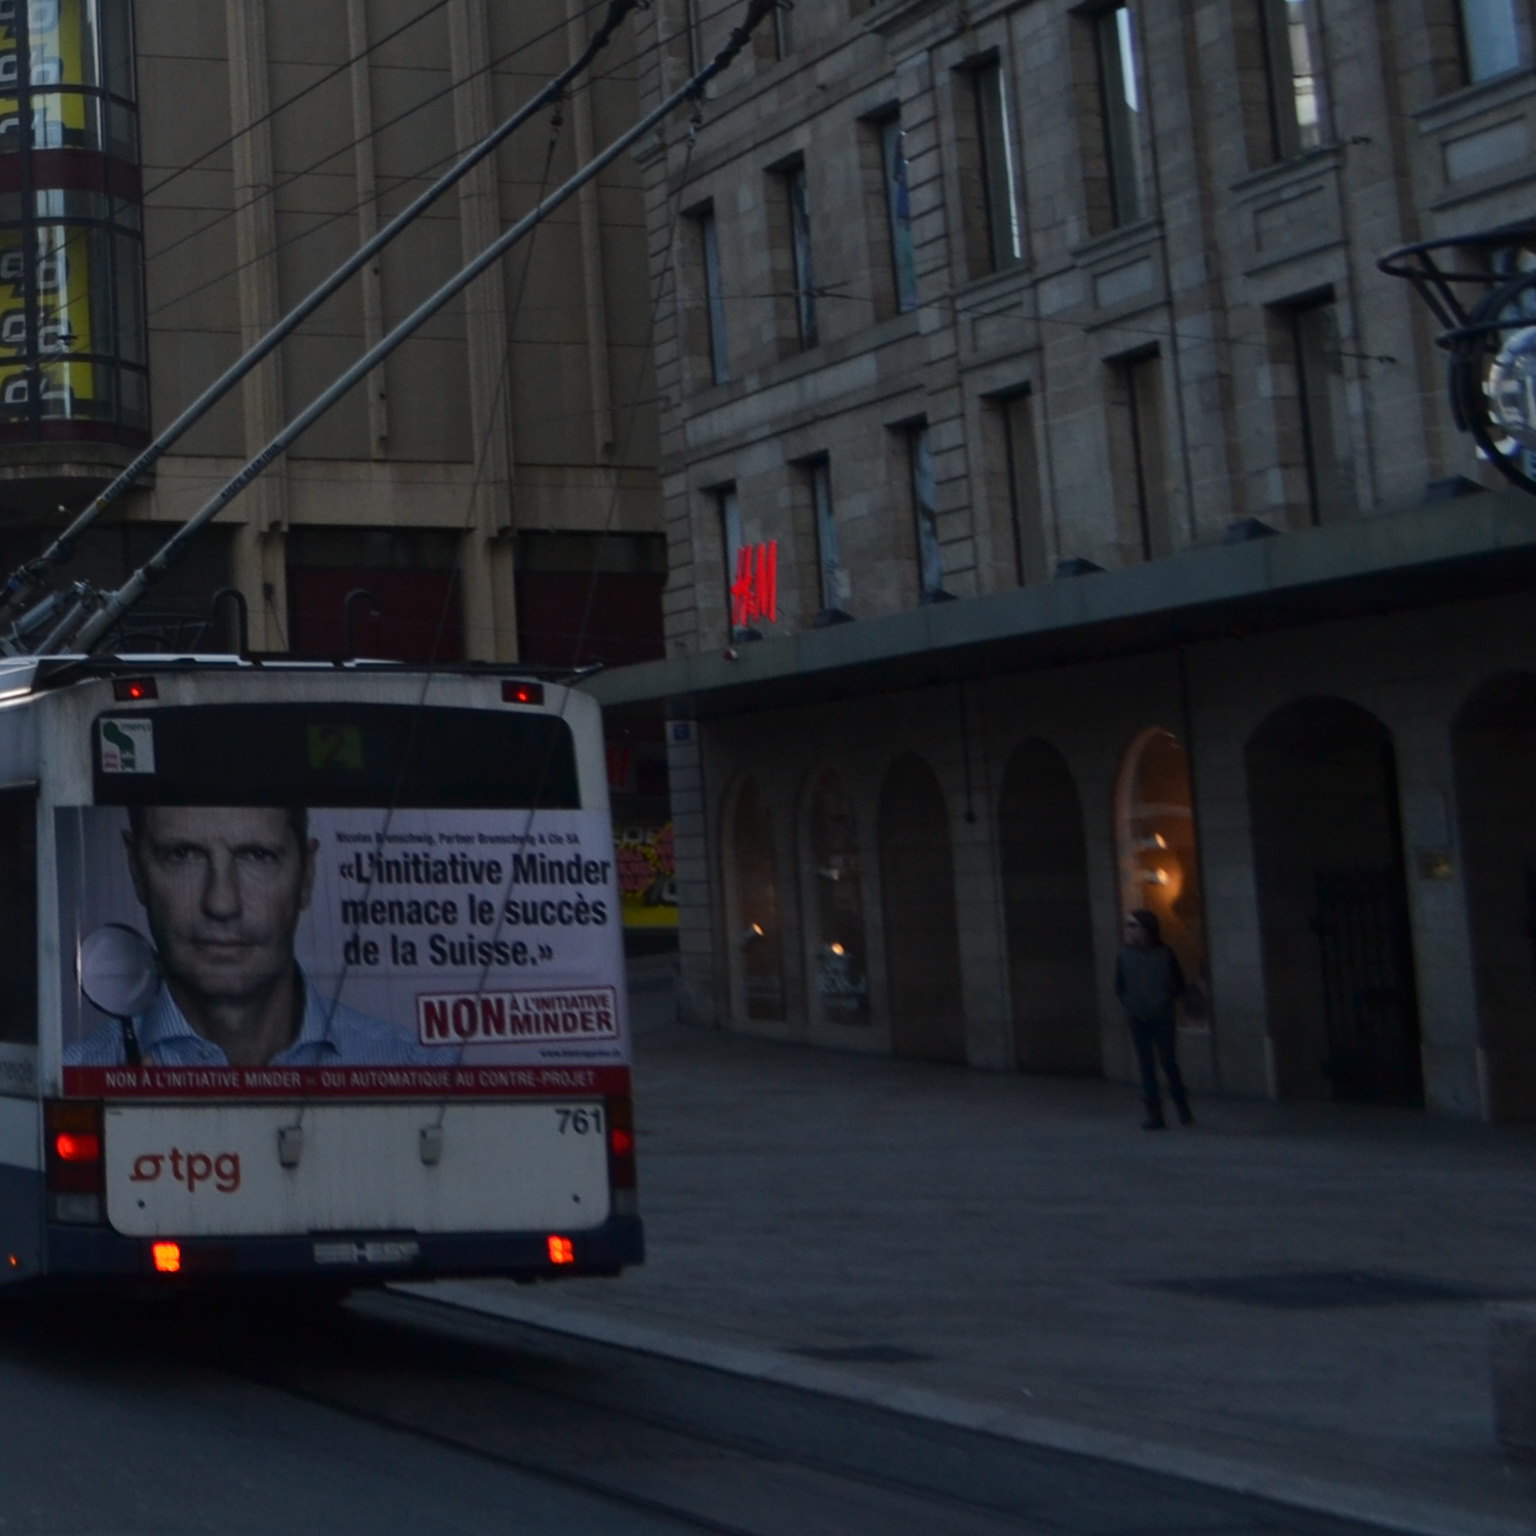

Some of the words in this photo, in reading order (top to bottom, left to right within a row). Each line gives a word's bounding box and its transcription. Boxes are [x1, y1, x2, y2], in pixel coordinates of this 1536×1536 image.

[512, 851, 611, 885] Minder
[341, 898, 458, 926] menace
[469, 894, 494, 925] le
[505, 891, 608, 926] succès
[344, 934, 379, 966] de
[391, 934, 418, 966] la
[423, 997, 507, 1039] NON
[524, 994, 610, 1012] L'INITIATIVE
[510, 1011, 614, 1035] MINDER
[105, 1071, 137, 1087] NON
[244, 1071, 302, 1088] MINDER
[321, 1071, 347, 1088] OUI
[351, 1070, 453, 1088] AUTOMATIQUE
[455, 1070, 474, 1087] AU
[480, 1069, 596, 1088] CONTRE-PROJET
[555, 1108, 602, 1135] 761
